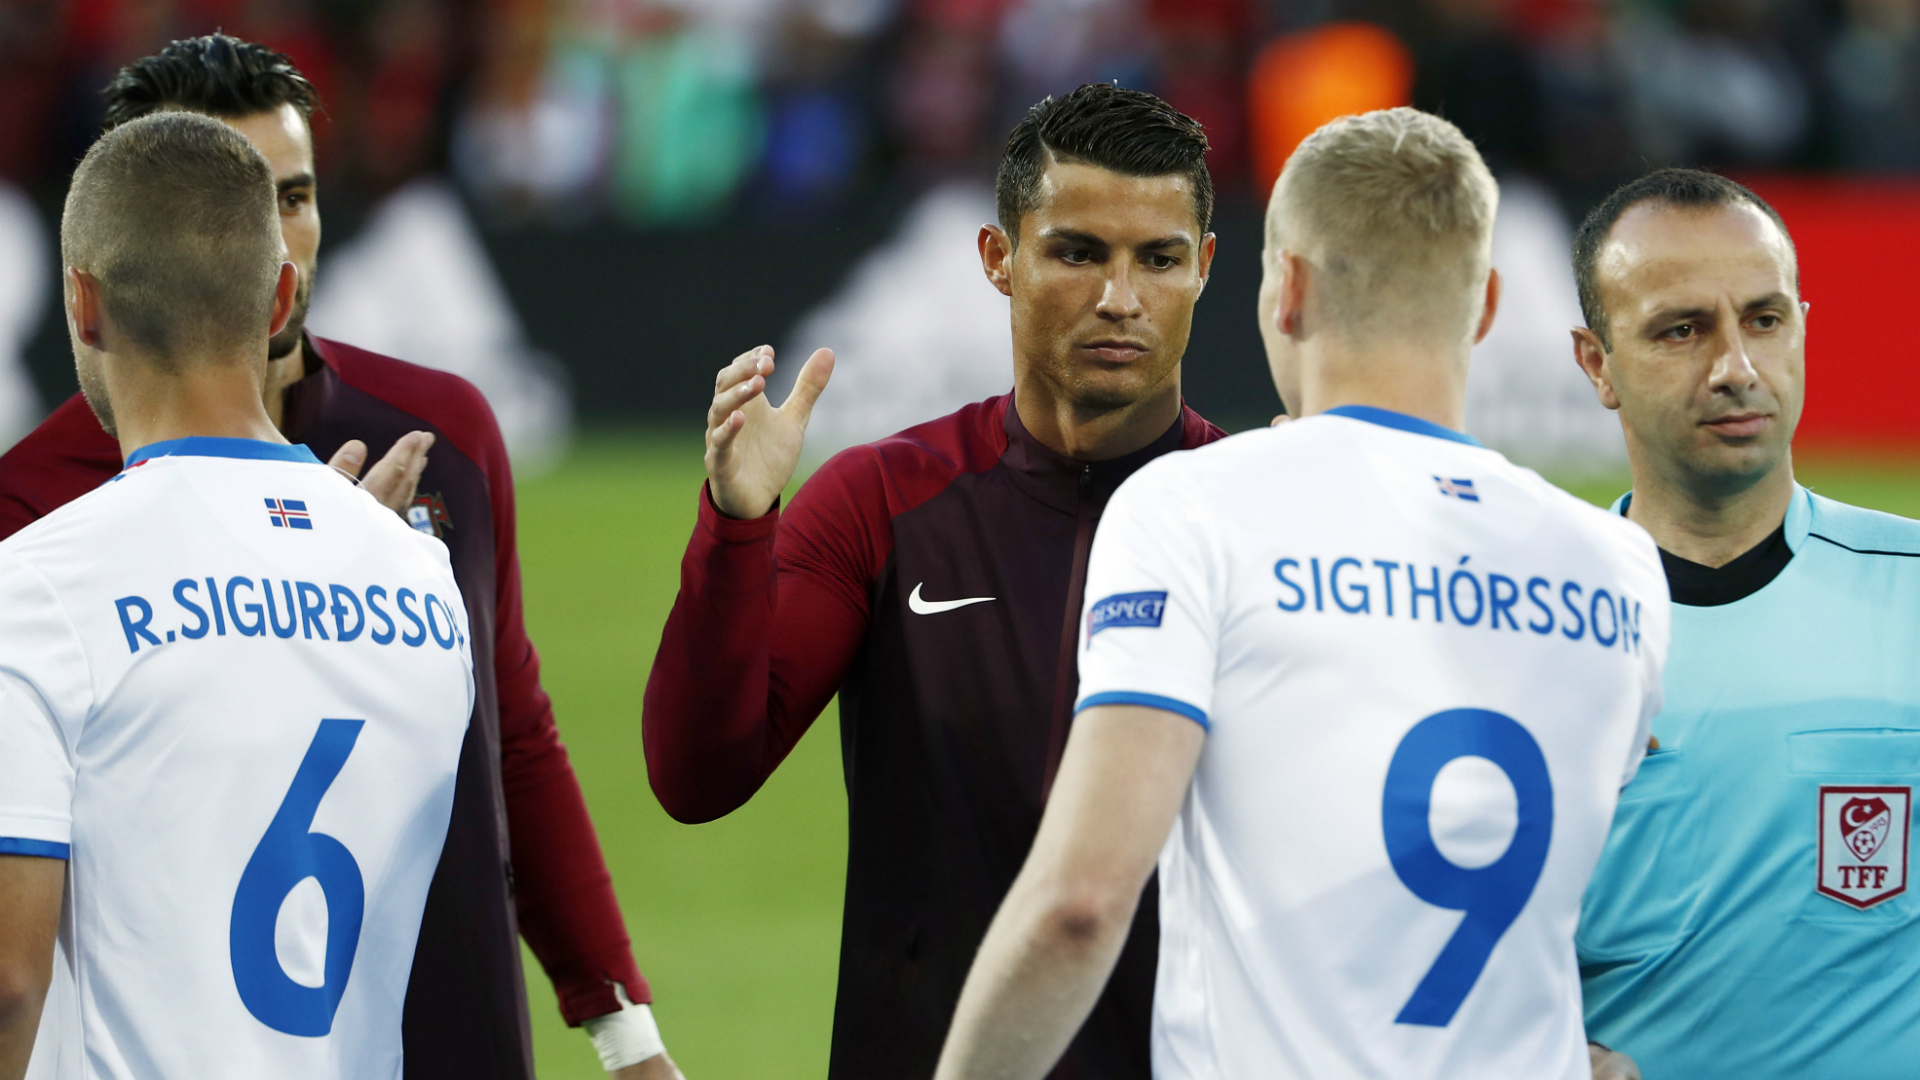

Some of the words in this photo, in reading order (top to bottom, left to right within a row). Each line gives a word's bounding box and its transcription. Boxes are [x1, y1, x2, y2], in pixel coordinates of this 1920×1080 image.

[1273, 555, 1641, 657] SIGTHÓRSSON
[230, 719, 365, 1037] 6
[1382, 708, 1554, 1028] 9
[1838, 865, 1888, 889] TFF
